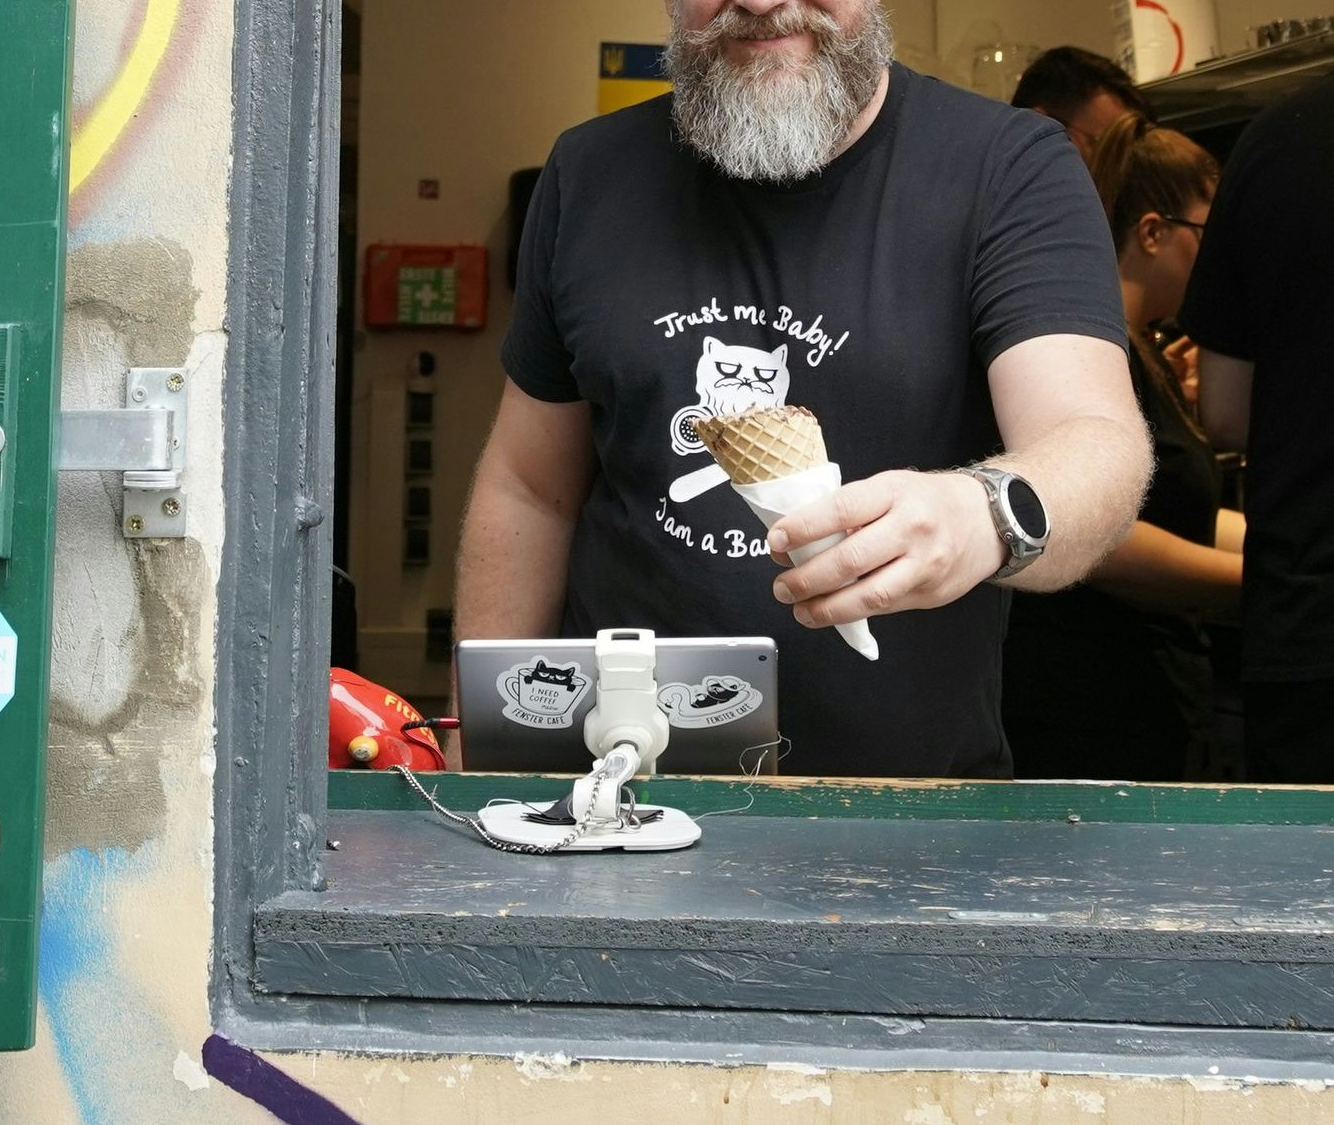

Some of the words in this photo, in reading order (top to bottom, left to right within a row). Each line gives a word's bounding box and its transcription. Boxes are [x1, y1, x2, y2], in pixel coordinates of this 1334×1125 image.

[654, 297, 728, 338] Trust
[734, 305, 767, 325] me
[772, 305, 849, 367] Baby!
[664, 517, 694, 547] am
[702, 535, 718, 554] a
